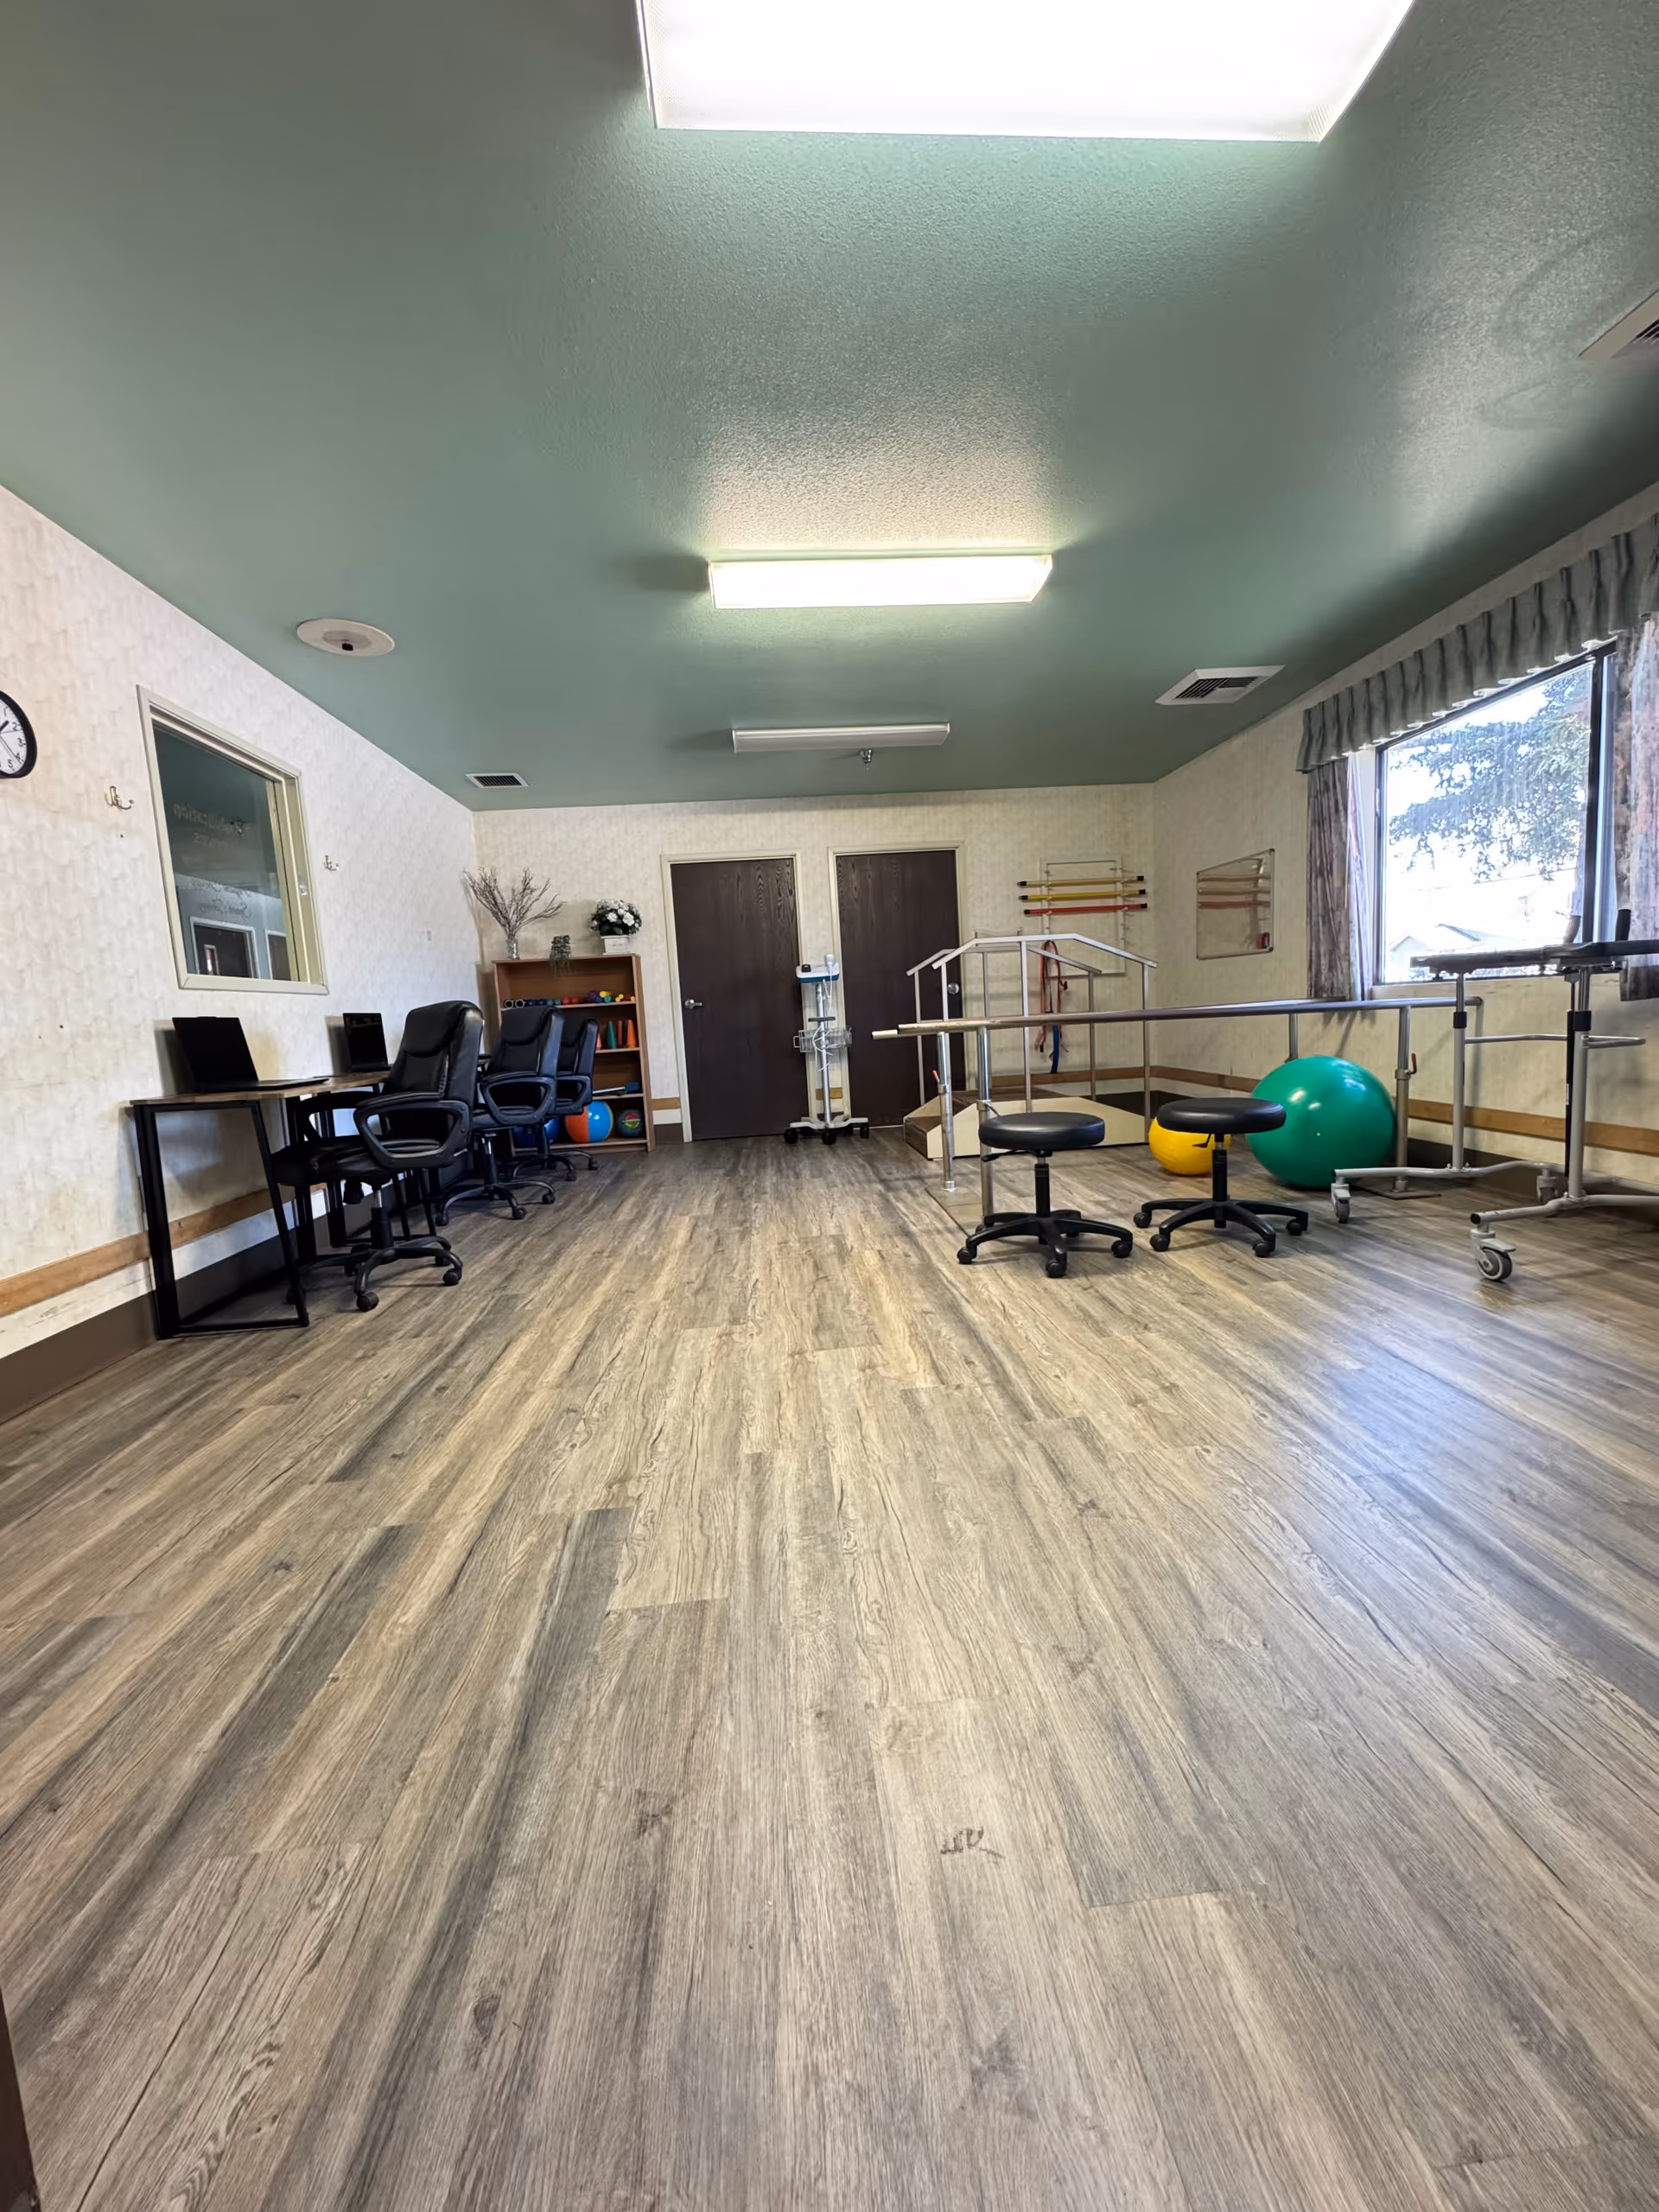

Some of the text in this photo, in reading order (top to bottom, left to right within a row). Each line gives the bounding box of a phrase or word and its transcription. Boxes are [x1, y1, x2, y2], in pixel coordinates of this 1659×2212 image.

[12, 721, 18, 732] 2
[17, 737, 23, 747] 3
[8, 759, 13, 768] 5
